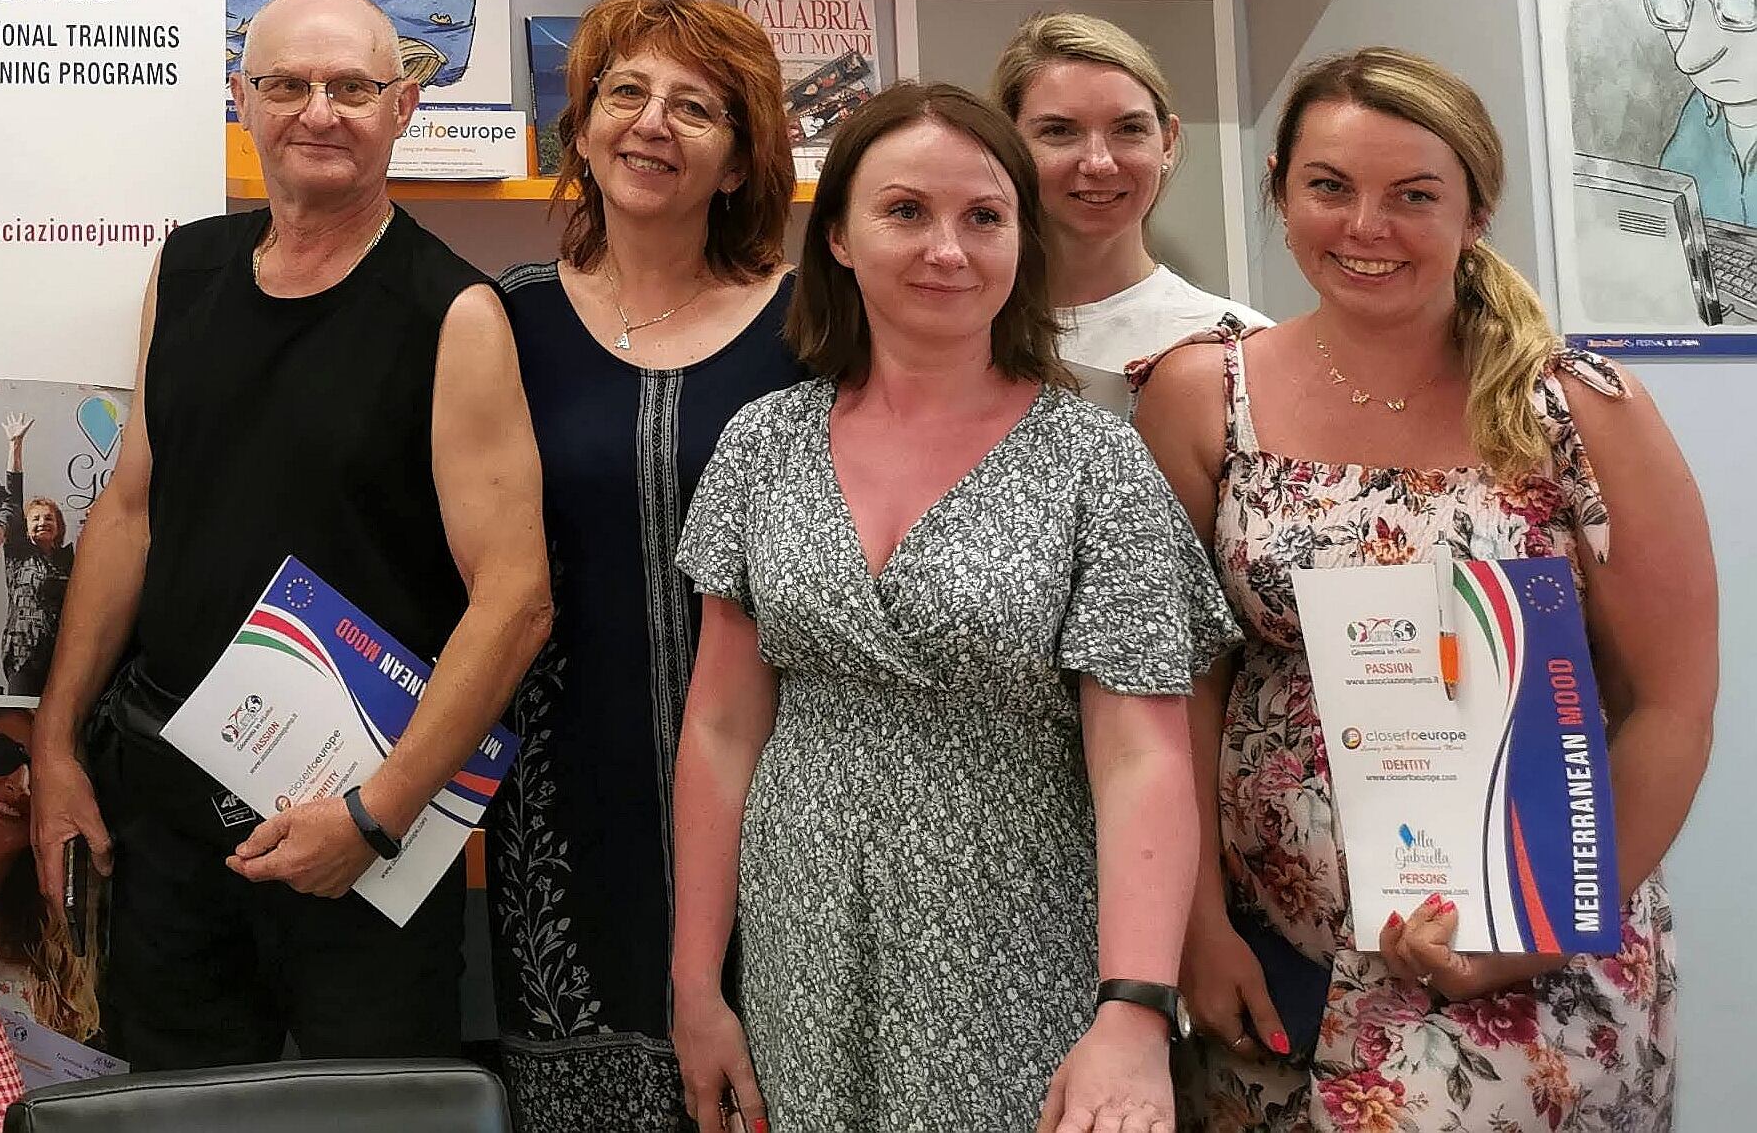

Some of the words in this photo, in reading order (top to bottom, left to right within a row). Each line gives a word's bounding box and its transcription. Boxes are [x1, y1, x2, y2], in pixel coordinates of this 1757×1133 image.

[66, 24, 181, 49] TRAININGS
[771, 32, 805, 54] PUT
[811, 33, 872, 56] MVNDI
[59, 62, 179, 86] PROGRAMS
[334, 617, 383, 663] MOOD
[1365, 662, 1414, 675] PASSION
[1547, 658, 1584, 725] MOOD
[251, 721, 281, 755] PASSION
[1365, 731, 1467, 743] closertoeurope
[1381, 759, 1432, 772] IDENTITY
[312, 769, 341, 803] DENTITY
[1561, 733, 1600, 933] MEDITERRANEAN
[1399, 873, 1448, 885] PERSONS
